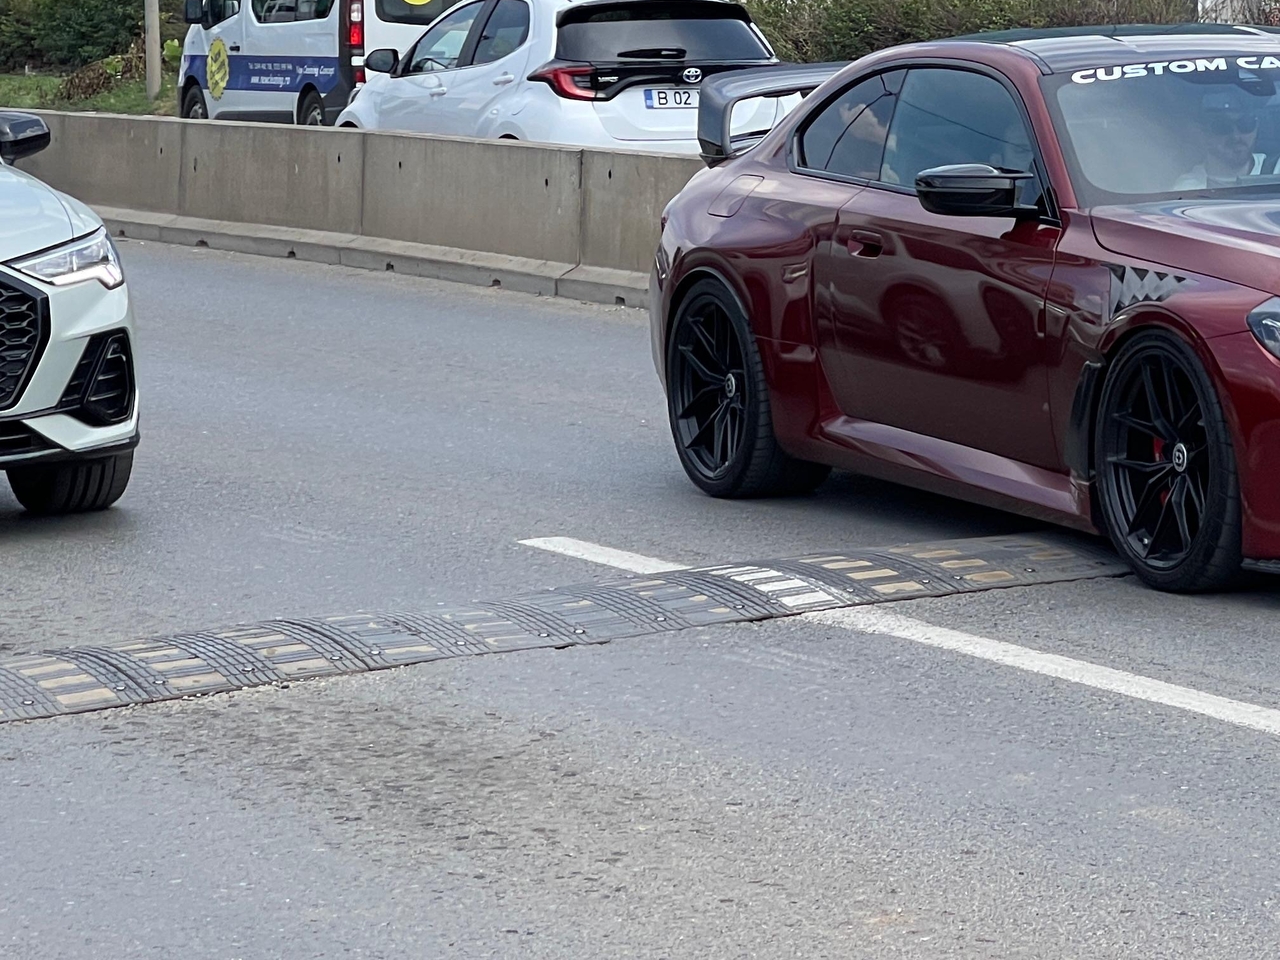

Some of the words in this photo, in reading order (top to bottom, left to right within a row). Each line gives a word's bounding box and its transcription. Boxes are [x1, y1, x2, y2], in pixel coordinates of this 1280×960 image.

[1071, 58, 1228, 84] CUSTOM
[657, 91, 668, 106] B
[673, 91, 692, 105] 02
